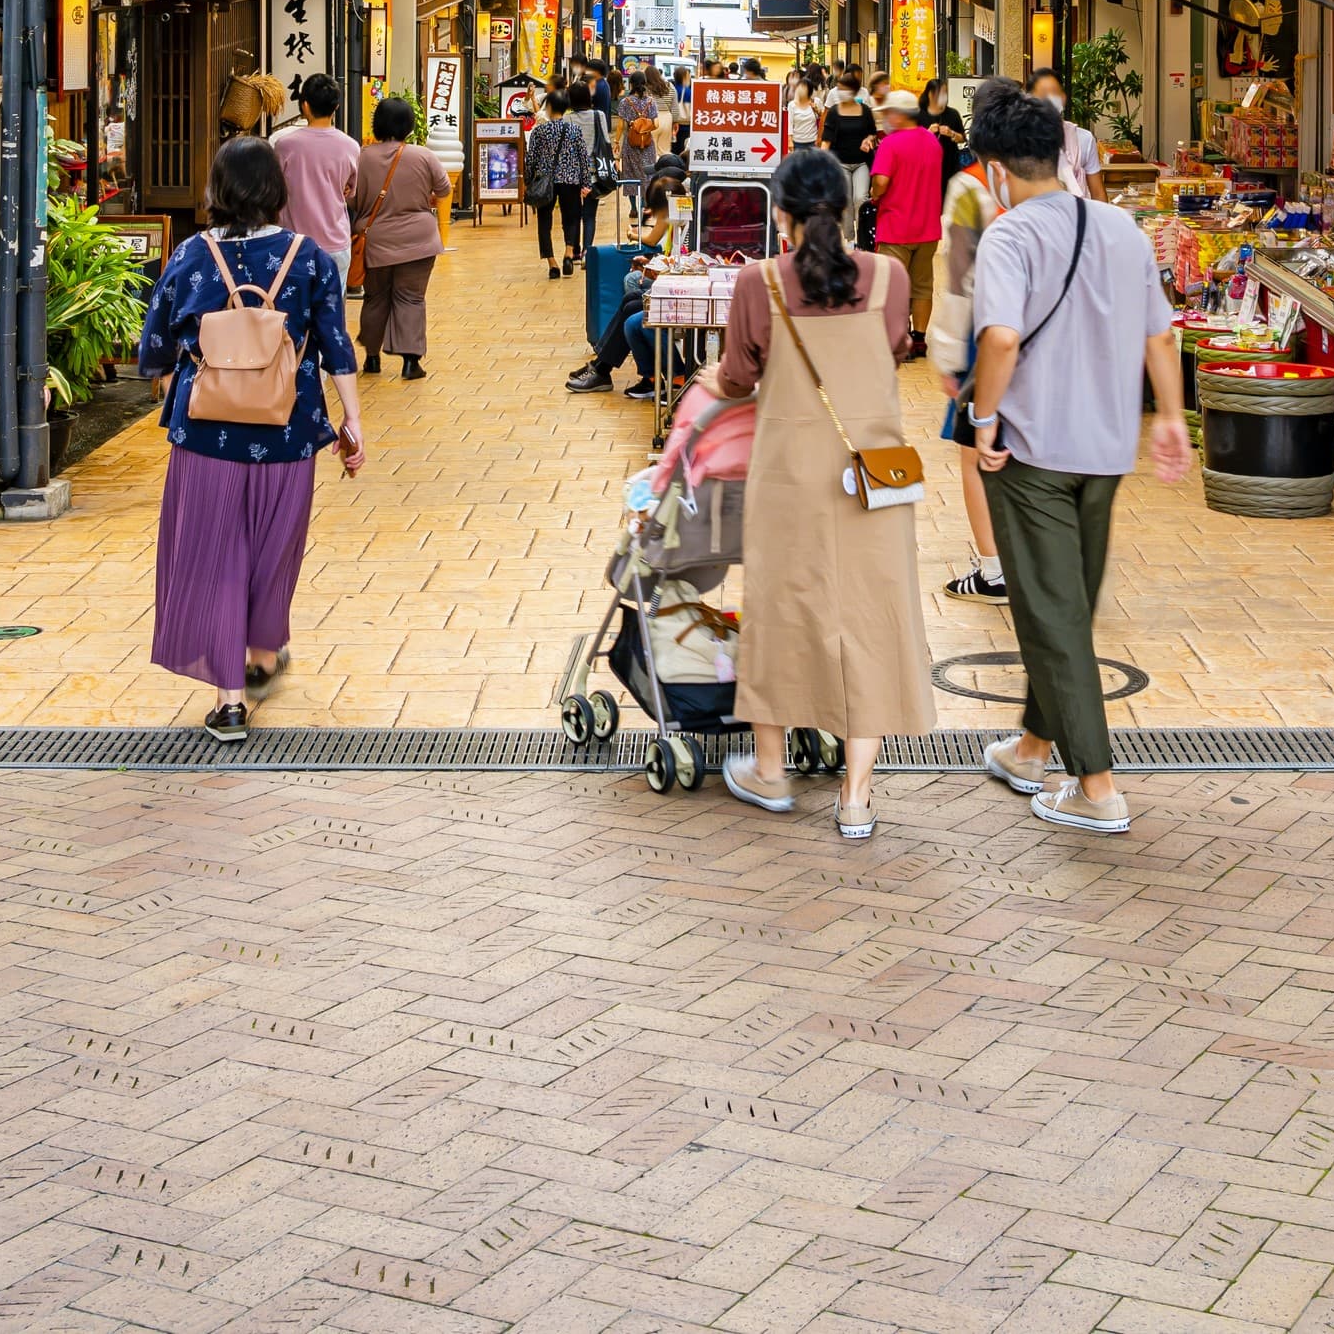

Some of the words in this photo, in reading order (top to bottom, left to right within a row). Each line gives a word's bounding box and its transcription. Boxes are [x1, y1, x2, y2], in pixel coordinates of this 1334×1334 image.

[706, 89, 767, 105] 熱海温泉
[694, 109, 778, 128] おみやげ処
[708, 136, 734, 148] 丸福
[693, 149, 746, 163] 高橋商店
